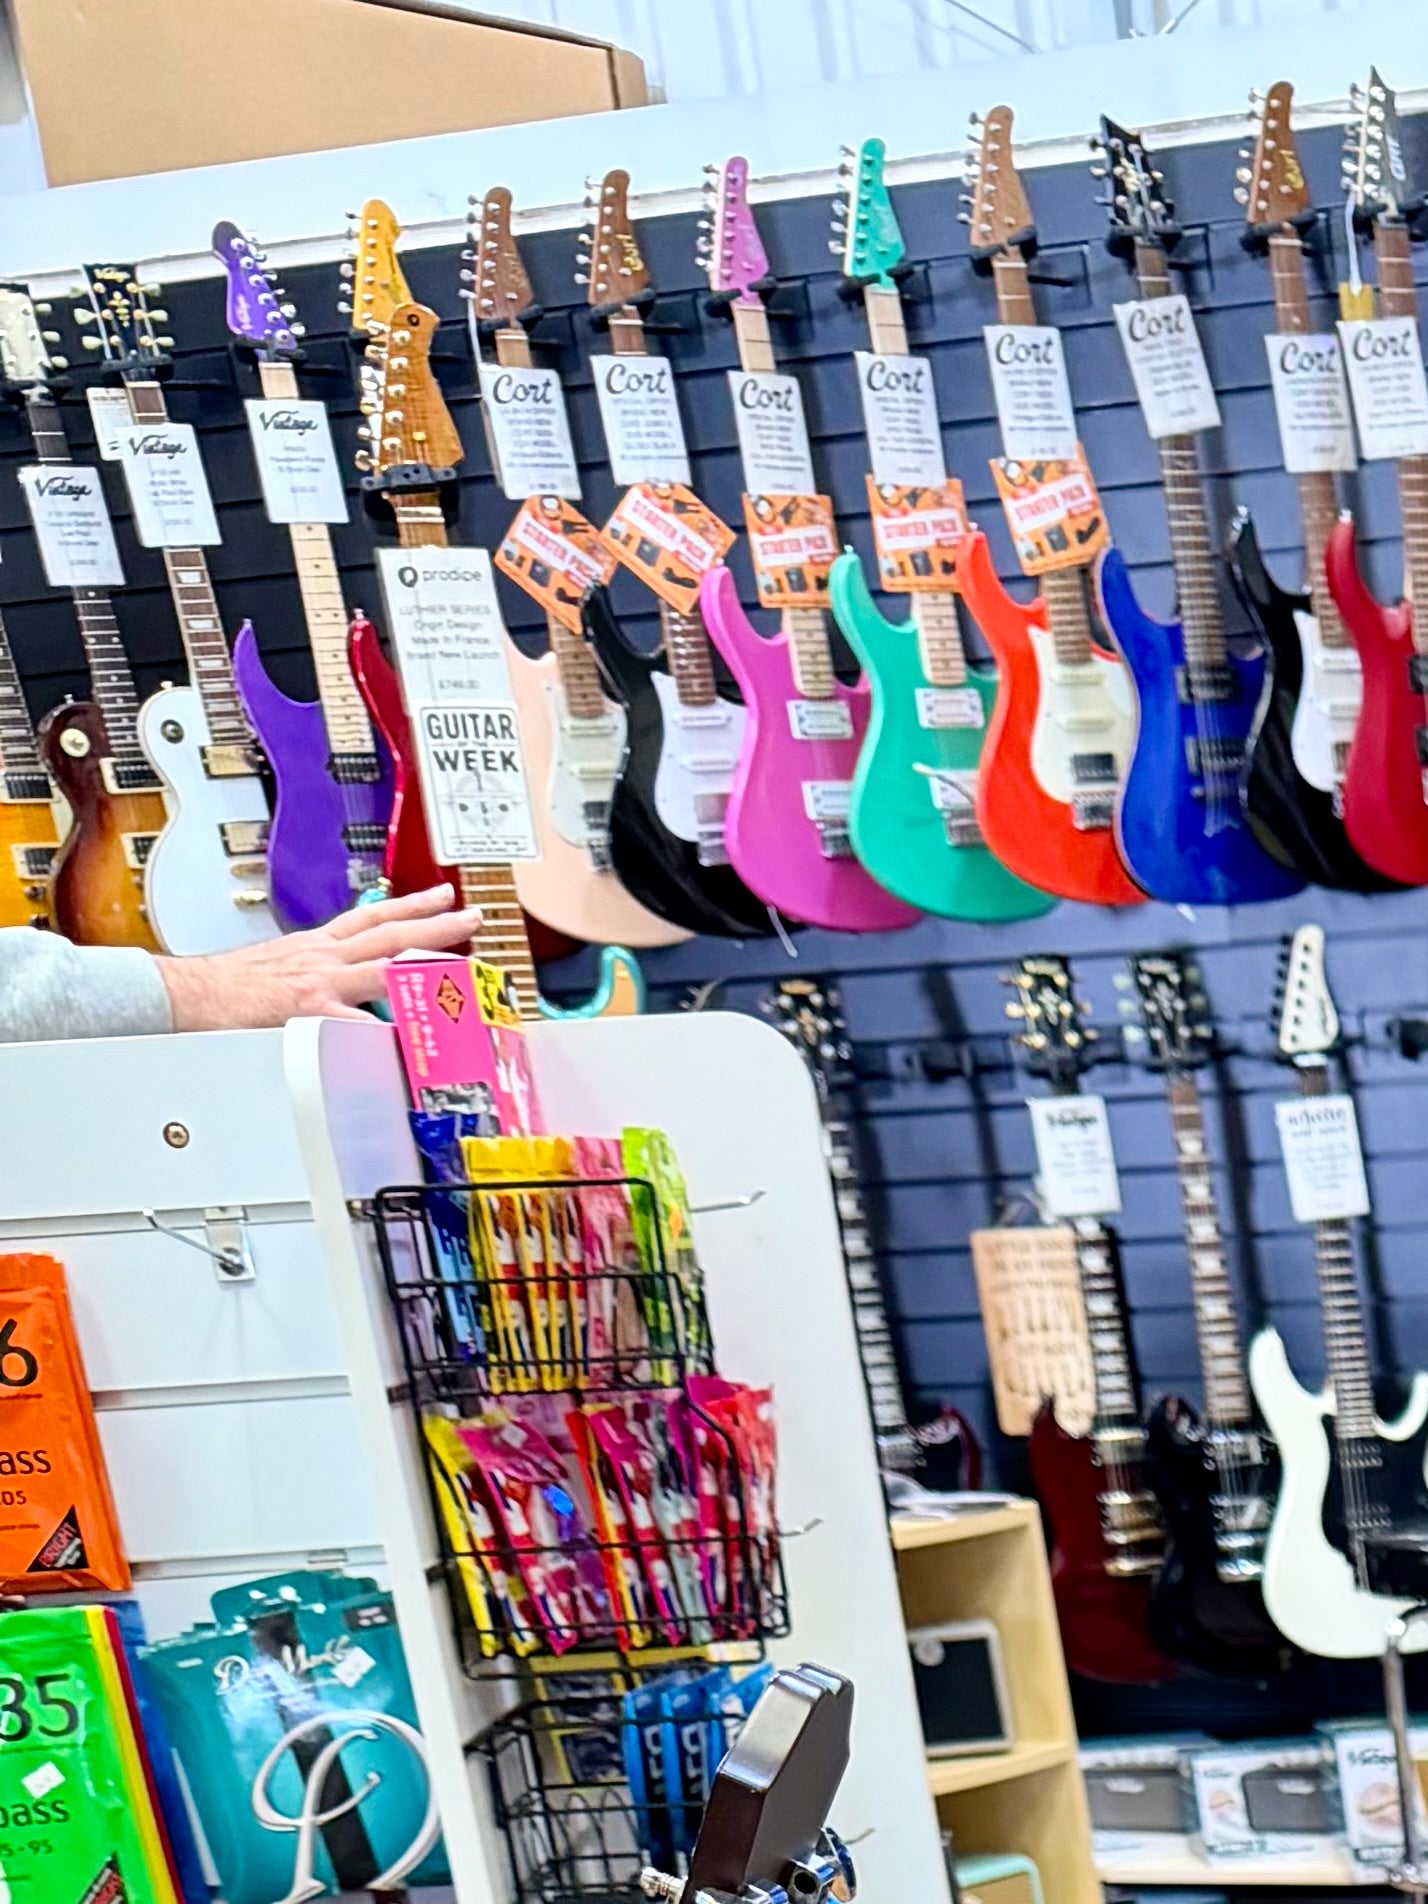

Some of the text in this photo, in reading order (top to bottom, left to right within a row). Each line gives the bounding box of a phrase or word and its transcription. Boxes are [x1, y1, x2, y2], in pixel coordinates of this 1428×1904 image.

[1128, 303, 1185, 342] Cort
[995, 333, 1054, 365] Cort
[1280, 342, 1336, 375] Cort
[1353, 328, 1411, 361] Cort
[493, 374, 552, 404] Cort
[606, 363, 667, 394] Cort
[867, 361, 923, 393] Cort
[740, 378, 793, 410] Cort
[259, 409, 318, 435] Vintage
[128, 434, 187, 459] Vintage
[34, 476, 92, 501] Vintage
[426, 713, 516, 741] GUITAR
[432, 749, 519, 772] WEEK
